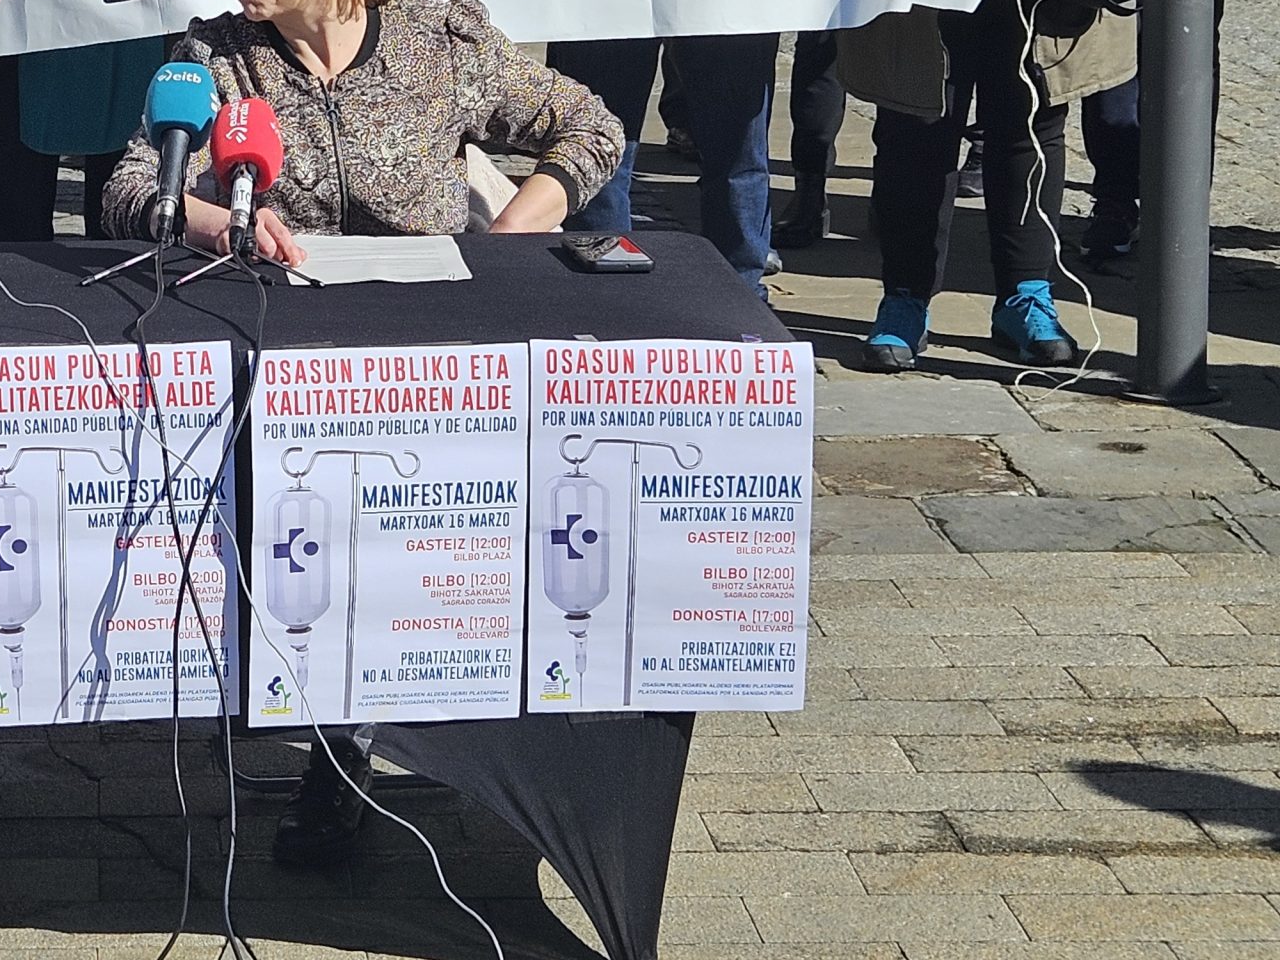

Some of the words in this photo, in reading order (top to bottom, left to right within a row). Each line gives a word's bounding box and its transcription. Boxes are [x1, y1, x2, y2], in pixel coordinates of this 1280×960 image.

[172, 71, 202, 84] eitb
[173, 351, 213, 376] ETA
[264, 357, 352, 386] OSASUN
[365, 355, 458, 383] PUBLIKO
[471, 355, 509, 380] ETA
[546, 349, 635, 374] OSASUN
[647, 349, 743, 374] PUBLIKO
[755, 350, 794, 374] ETA
[164, 381, 216, 407] ALDE
[266, 386, 453, 417] KALITATEZKOAREN
[461, 385, 511, 411] ALDE
[546, 380, 736, 404] KALITATEZKOAREN
[745, 380, 796, 404] ALDE
[24, 418, 78, 435] SANIDAD
[82, 412, 134, 433] PÚBLICA
[169, 412, 222, 430] CALIDAD
[263, 423, 286, 439] POR
[291, 422, 316, 438] UNA
[320, 421, 373, 438] SANIDAD
[378, 415, 429, 436] PÚBLICA
[435, 419, 441, 434] Y
[446, 418, 460, 434] DE
[465, 416, 517, 433] CALIDAD
[542, 411, 566, 426] POR
[571, 411, 595, 426] UNA
[601, 412, 655, 427] SANIDAD
[660, 408, 712, 427] PÚBLICA
[718, 412, 724, 427] Y
[729, 412, 744, 427] DE
[749, 412, 802, 427] CALIDAD
[67, 476, 226, 506] MANIFESTAZIOAK
[361, 480, 518, 509] MANIFESTAZIOAK
[641, 475, 802, 498] MANIFESTAZIOAK
[87, 511, 153, 528] MARTXOAK
[380, 515, 445, 531] MARTXOAK
[449, 514, 464, 528] 16
[469, 512, 510, 528] MARZO
[660, 507, 726, 522] MARTXOAK
[731, 507, 747, 521] 16
[752, 507, 794, 521] MARZO
[688, 532, 748, 543] GASTEIZ
[754, 531, 795, 545] [12:00]
[133, 572, 177, 586] BILBO
[704, 568, 748, 579] BILBO
[753, 567, 794, 581] [12:00]
[673, 610, 747, 621] DONOSTIA
[753, 610, 794, 623] [17:00]
[401, 649, 491, 666] PRIBATIZAZIORIK
[496, 649, 511, 662] EZ!
[682, 642, 775, 656] PRIBATIZAZIORIK
[780, 643, 795, 656] EZ!
[362, 670, 376, 683] NO
[380, 669, 394, 682] AL
[398, 664, 511, 682] DESMANTELAMIENTO
[642, 658, 656, 670] NO
[661, 658, 674, 671] AL
[679, 658, 795, 672] DESMANTELAMIENTO
